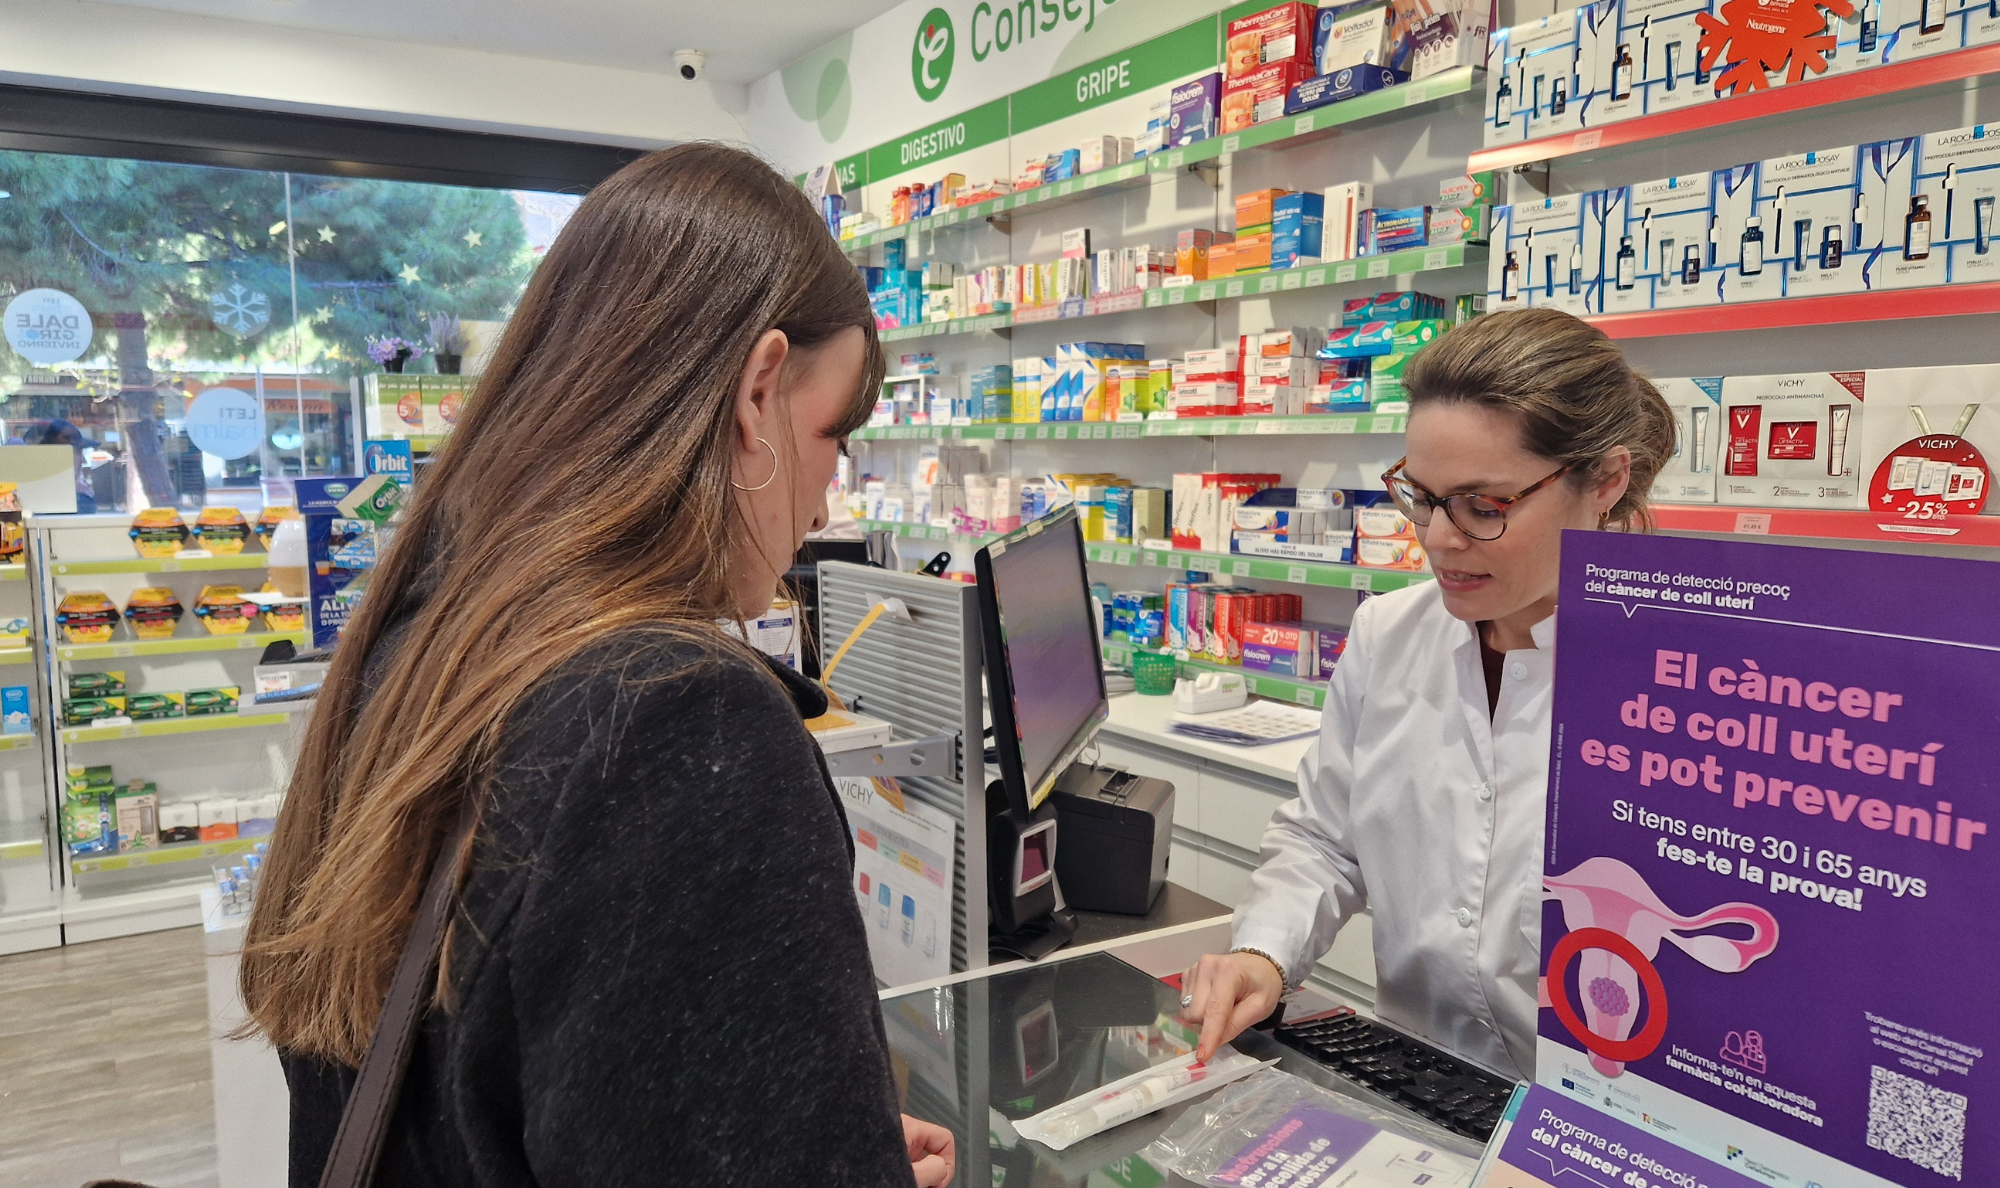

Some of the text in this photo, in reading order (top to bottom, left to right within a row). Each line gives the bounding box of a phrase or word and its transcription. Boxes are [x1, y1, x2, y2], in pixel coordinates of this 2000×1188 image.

[971, 0, 1117, 62] Consej
[1233, 6, 1291, 31] ThermaCare
[1746, 18, 1786, 34] Neutrogena
[1077, 60, 1130, 102] GRIPE
[1228, 67, 1281, 89] ThermaCare
[901, 122, 965, 165] DIGESTIVO
[1778, 379, 1805, 387] VICHY
[1918, 439, 1958, 449] VICHY
[369, 452, 409, 474] Orbit
[374, 486, 399, 510] Orbit
[1773, 486, 1780, 497] 2
[1818, 486, 1825, 497] 3
[1897, 501, 1949, 520] -25%
[1585, 563, 1791, 601] Programa de detecció precoç
[1585, 579, 1755, 611] del càncer de coll uterí
[1261, 627, 1279, 646] 20
[1285, 632, 1298, 640] DTO
[1243, 649, 1271, 662] fisiocrem
[1654, 649, 1903, 723] El càncer
[1620, 693, 1945, 786] de coll uterí
[839, 780, 874, 806] VICHY
[1580, 738, 1987, 851] es pot prevenir
[1611, 799, 1927, 898] Si tens entre 30 i 65 anys
[1656, 837, 1863, 911] fes-te la prova!
[1665, 1054, 1722, 1087] farmàcia
[1672, 1044, 1817, 1111] Informa-te'n en aquesta
[1308, 1138, 1331, 1153] de
[1531, 1127, 1648, 1188] del càncer de
[1539, 1108, 1697, 1187] Programa de detecció
